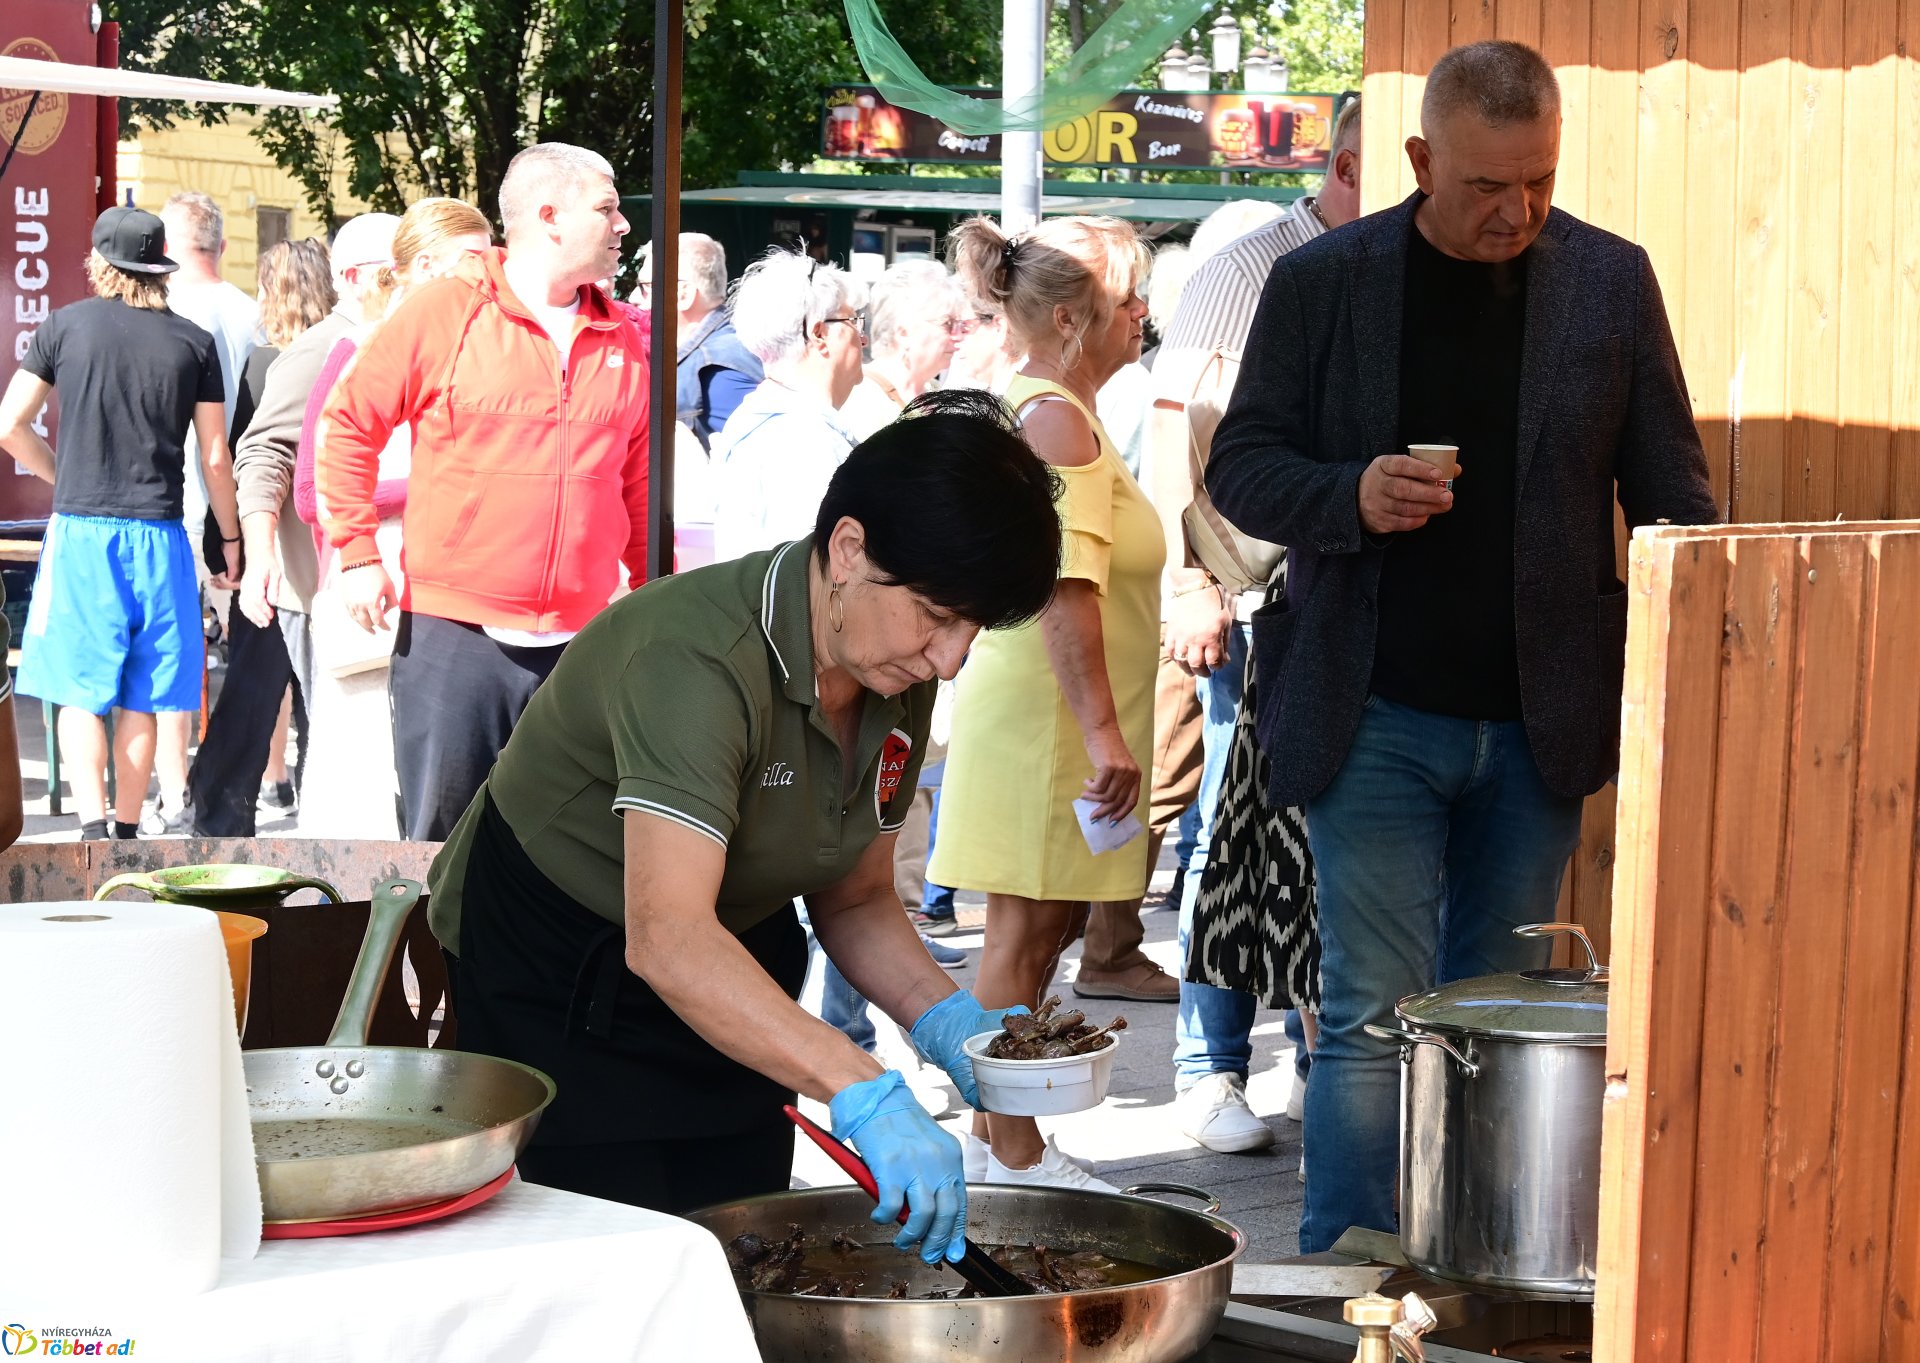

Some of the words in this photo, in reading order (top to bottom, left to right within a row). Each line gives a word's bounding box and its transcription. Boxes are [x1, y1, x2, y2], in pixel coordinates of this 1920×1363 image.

[5, 92, 58, 123] SOUCED
[1042, 96, 1138, 163] ÖR
[760, 762, 794, 788] illa
